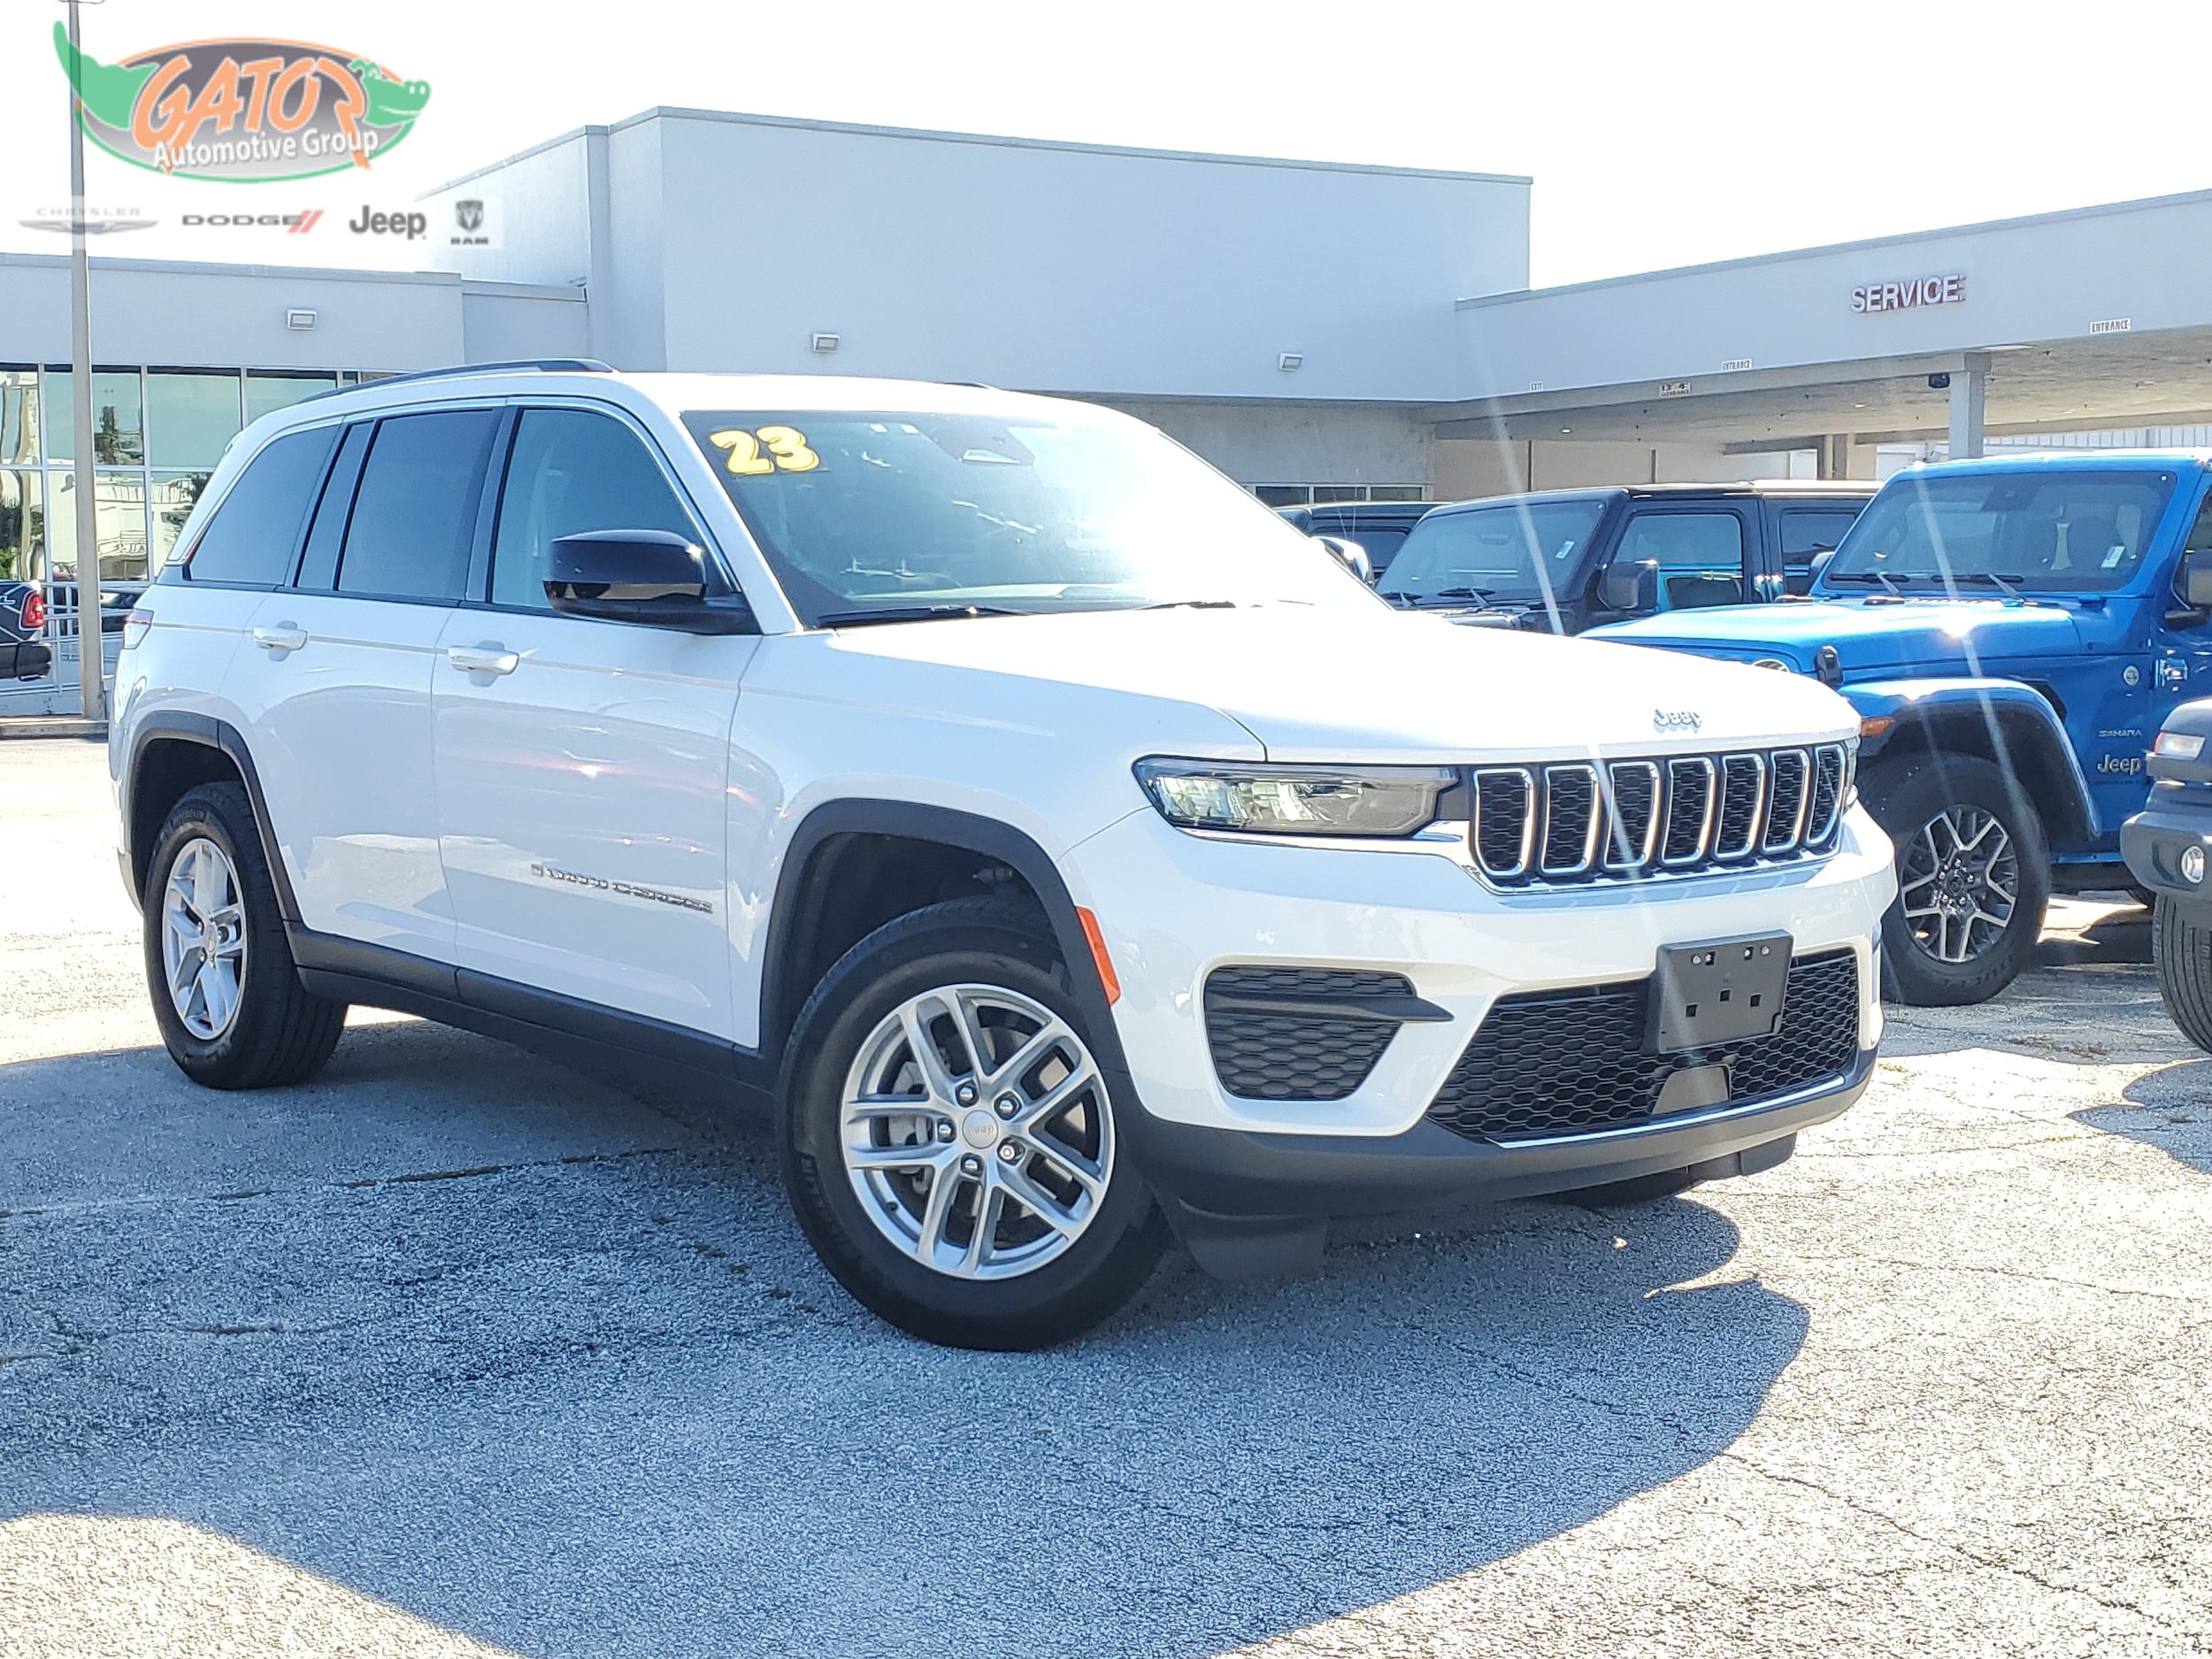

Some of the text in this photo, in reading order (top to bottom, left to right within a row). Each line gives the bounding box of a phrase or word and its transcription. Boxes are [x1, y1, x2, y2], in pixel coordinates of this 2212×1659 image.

[1850, 273, 1966, 313] SERVICE
[2092, 319, 2129, 334] ENTRANCE
[709, 425, 820, 475] 23
[2097, 754, 2141, 775] Jeep
